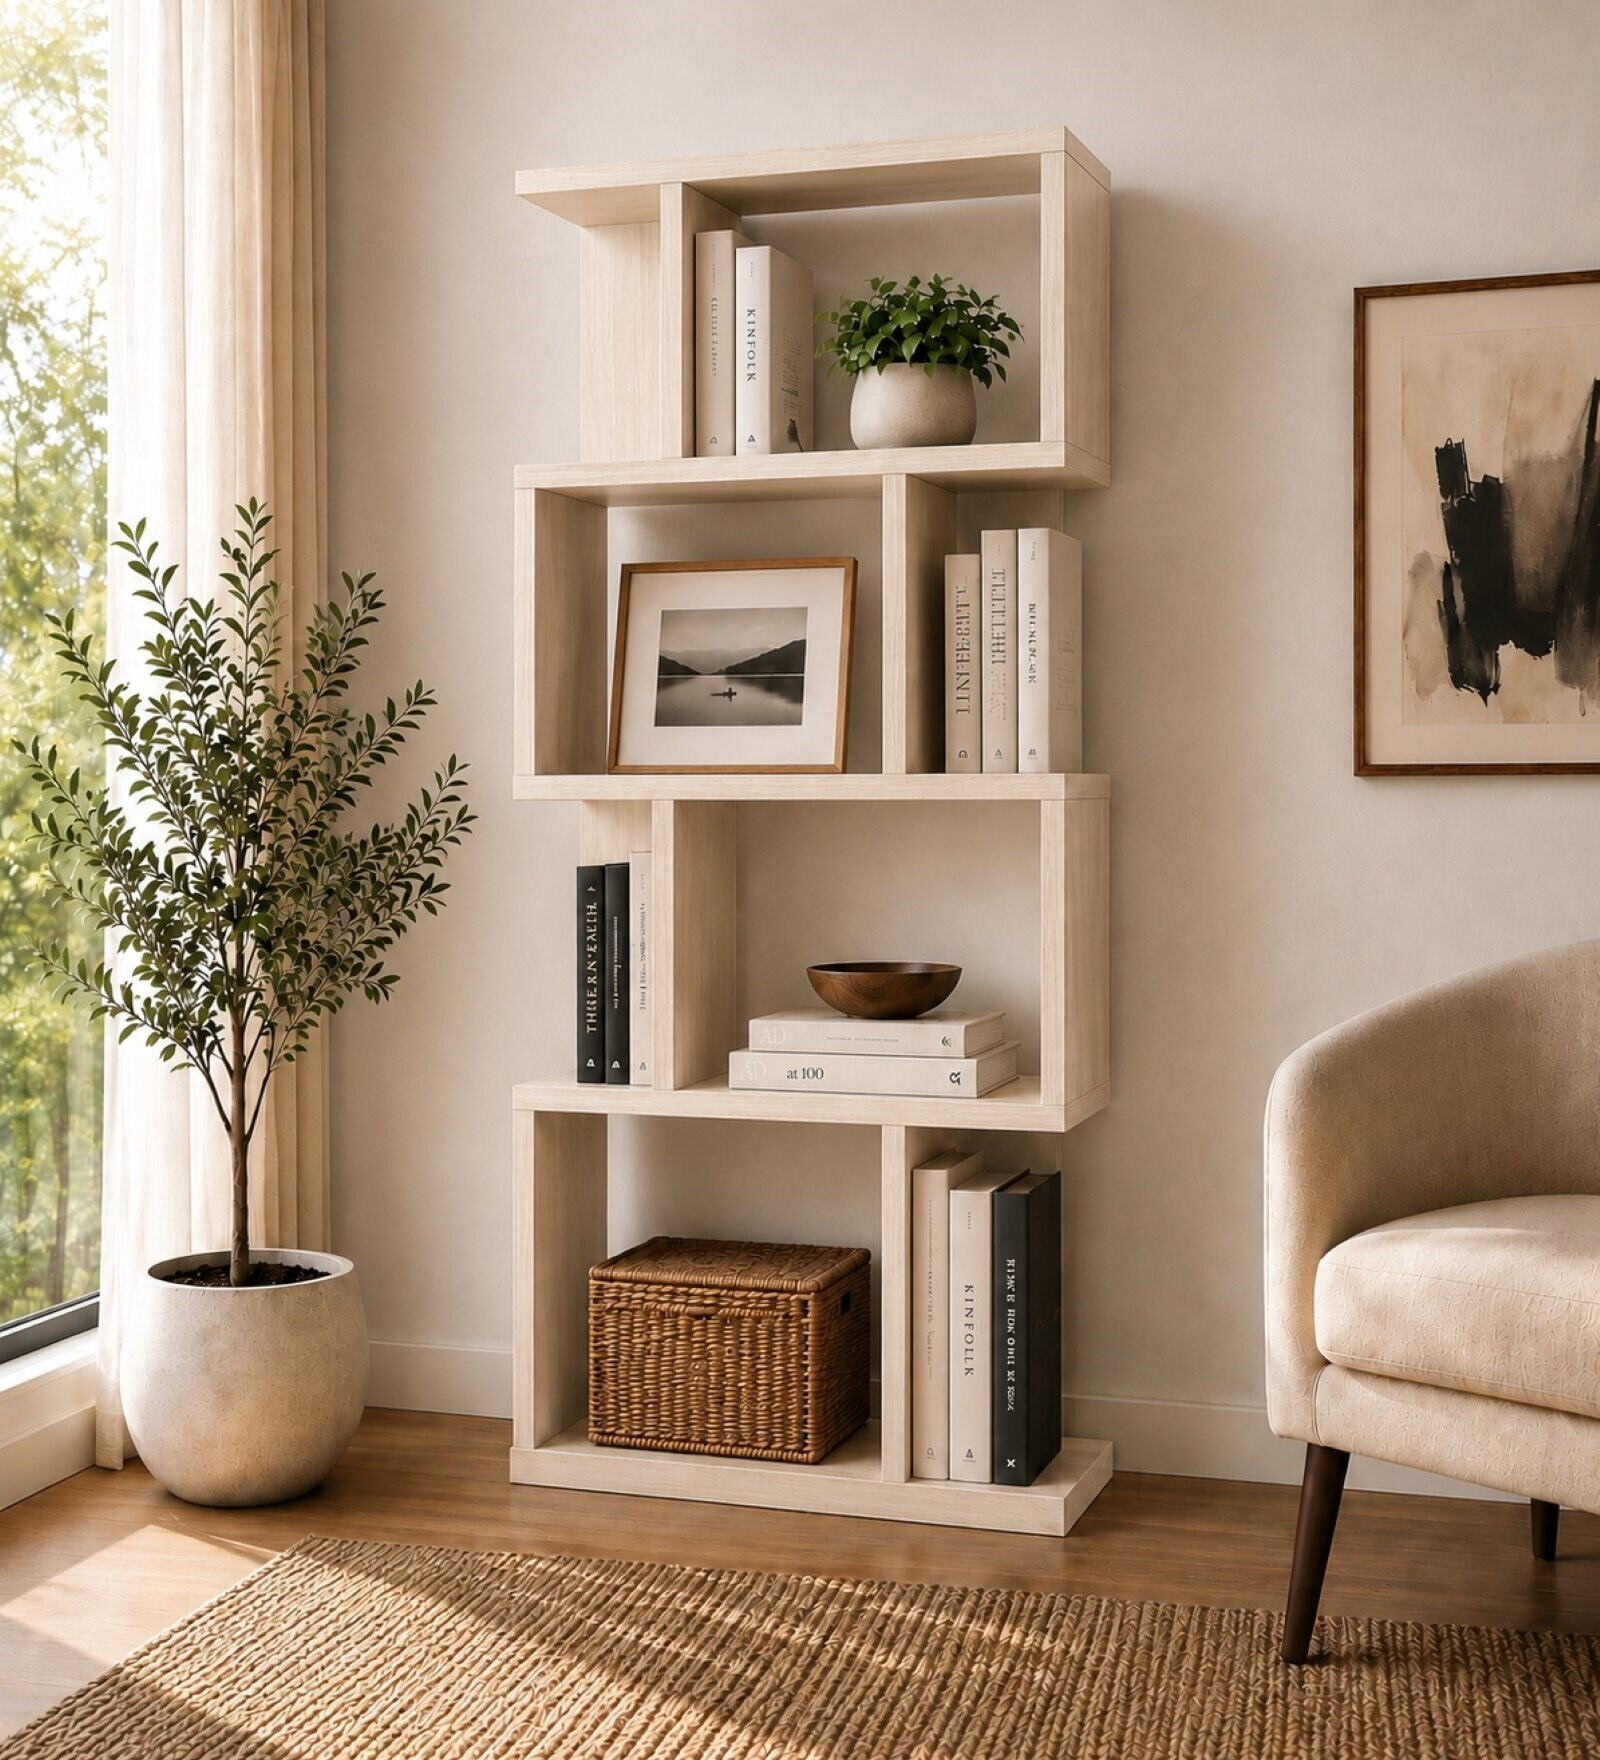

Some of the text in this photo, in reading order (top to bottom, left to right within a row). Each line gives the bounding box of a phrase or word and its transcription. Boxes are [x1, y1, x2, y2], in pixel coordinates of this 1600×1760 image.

[746, 308, 756, 382] KINFOLK
[786, 1069, 799, 1080] at
[801, 1066, 825, 1080] 100
